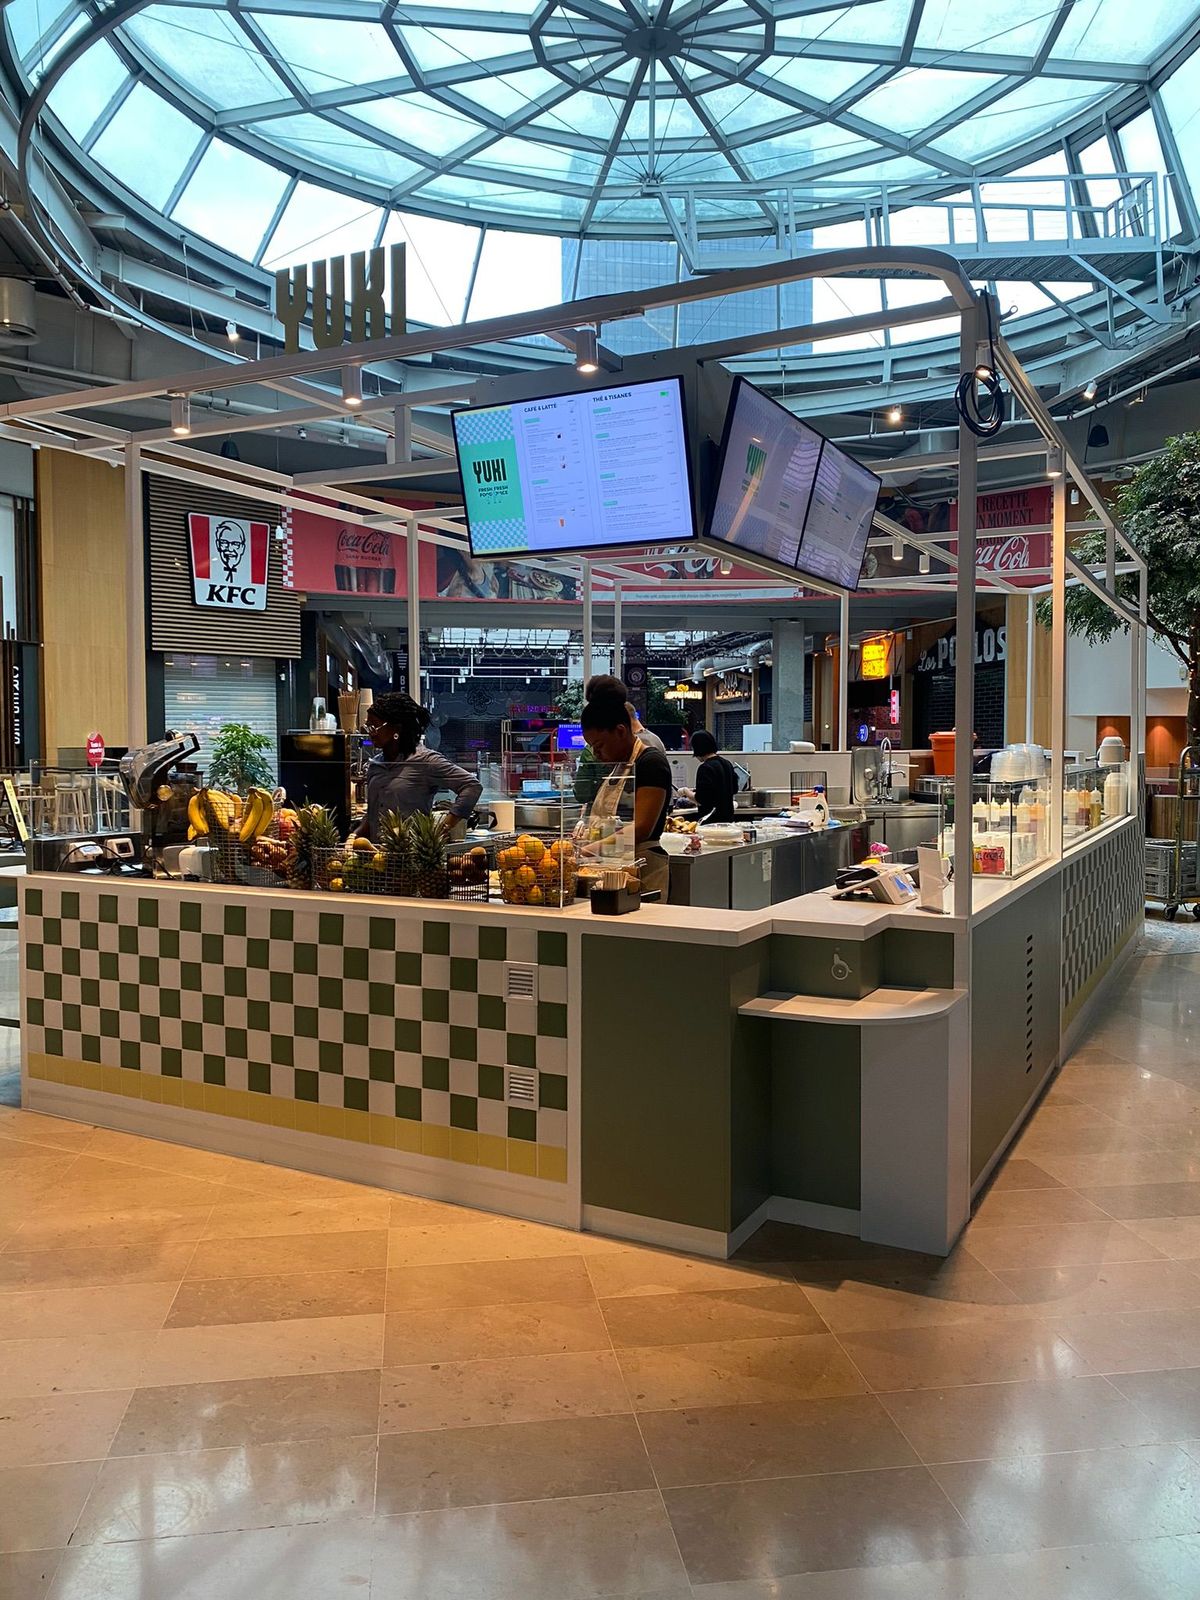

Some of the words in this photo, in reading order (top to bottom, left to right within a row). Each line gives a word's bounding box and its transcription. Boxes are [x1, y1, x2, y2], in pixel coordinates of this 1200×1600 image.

[276, 242, 406, 355] YUKI
[608, 392, 632, 400] TISANES
[472, 458, 507, 484] YUKI
[988, 508, 1034, 527] MOMENT
[337, 529, 390, 555] Coca-Cola
[976, 535, 1030, 572] ca-Cola
[206, 584, 256, 605] KFC
[918, 650, 937, 672] Los
[938, 626, 1007, 669] POLOS
